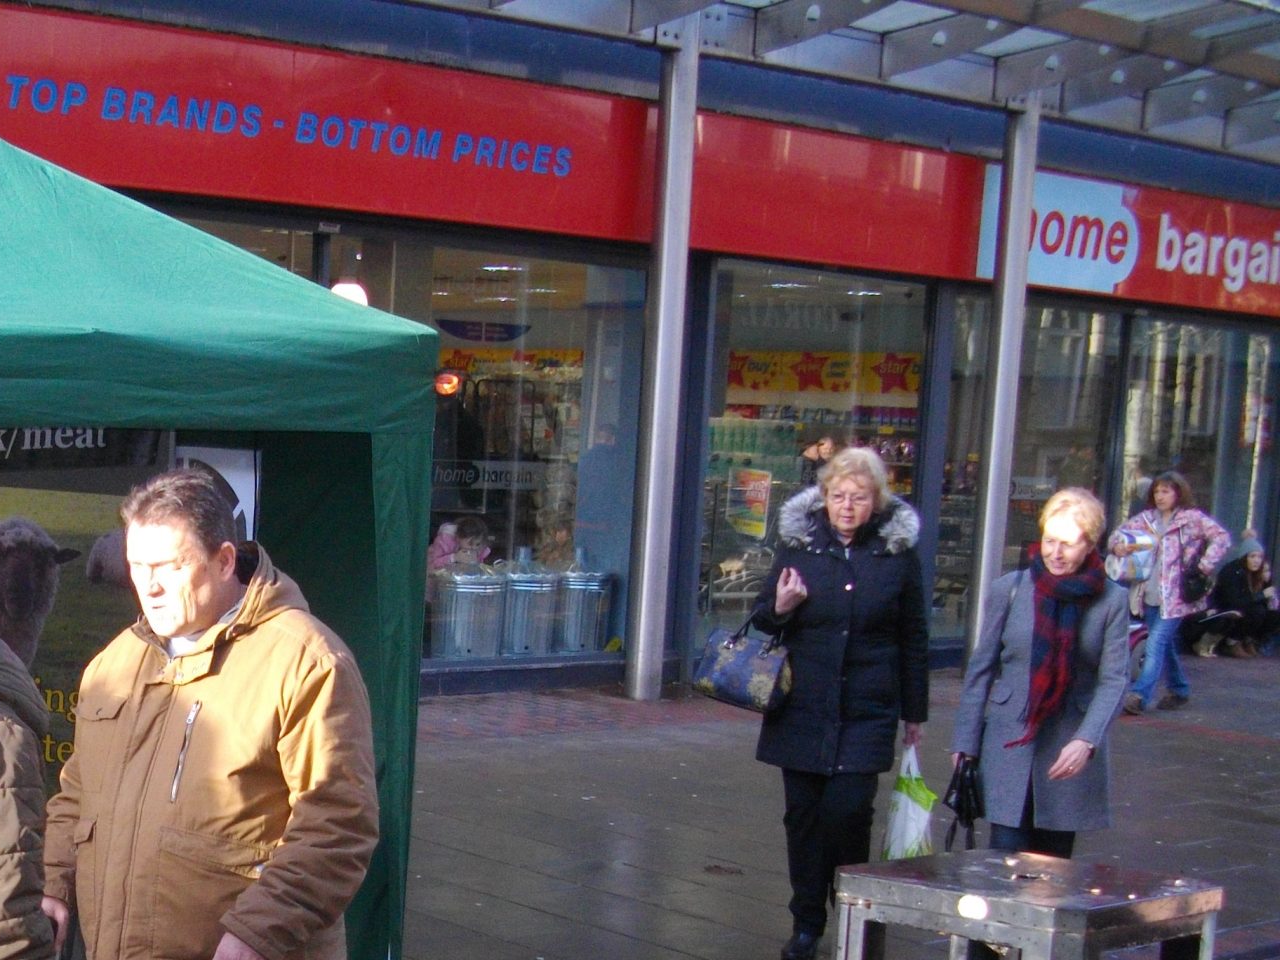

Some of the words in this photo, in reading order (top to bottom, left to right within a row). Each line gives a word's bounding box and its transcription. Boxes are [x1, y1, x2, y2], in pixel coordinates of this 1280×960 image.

[5, 74, 88, 115] TOP
[100, 86, 264, 139] BRANDS
[294, 111, 442, 160] BOTTOM
[452, 133, 574, 178] PRICES
[482, 465, 536, 488] bargain
